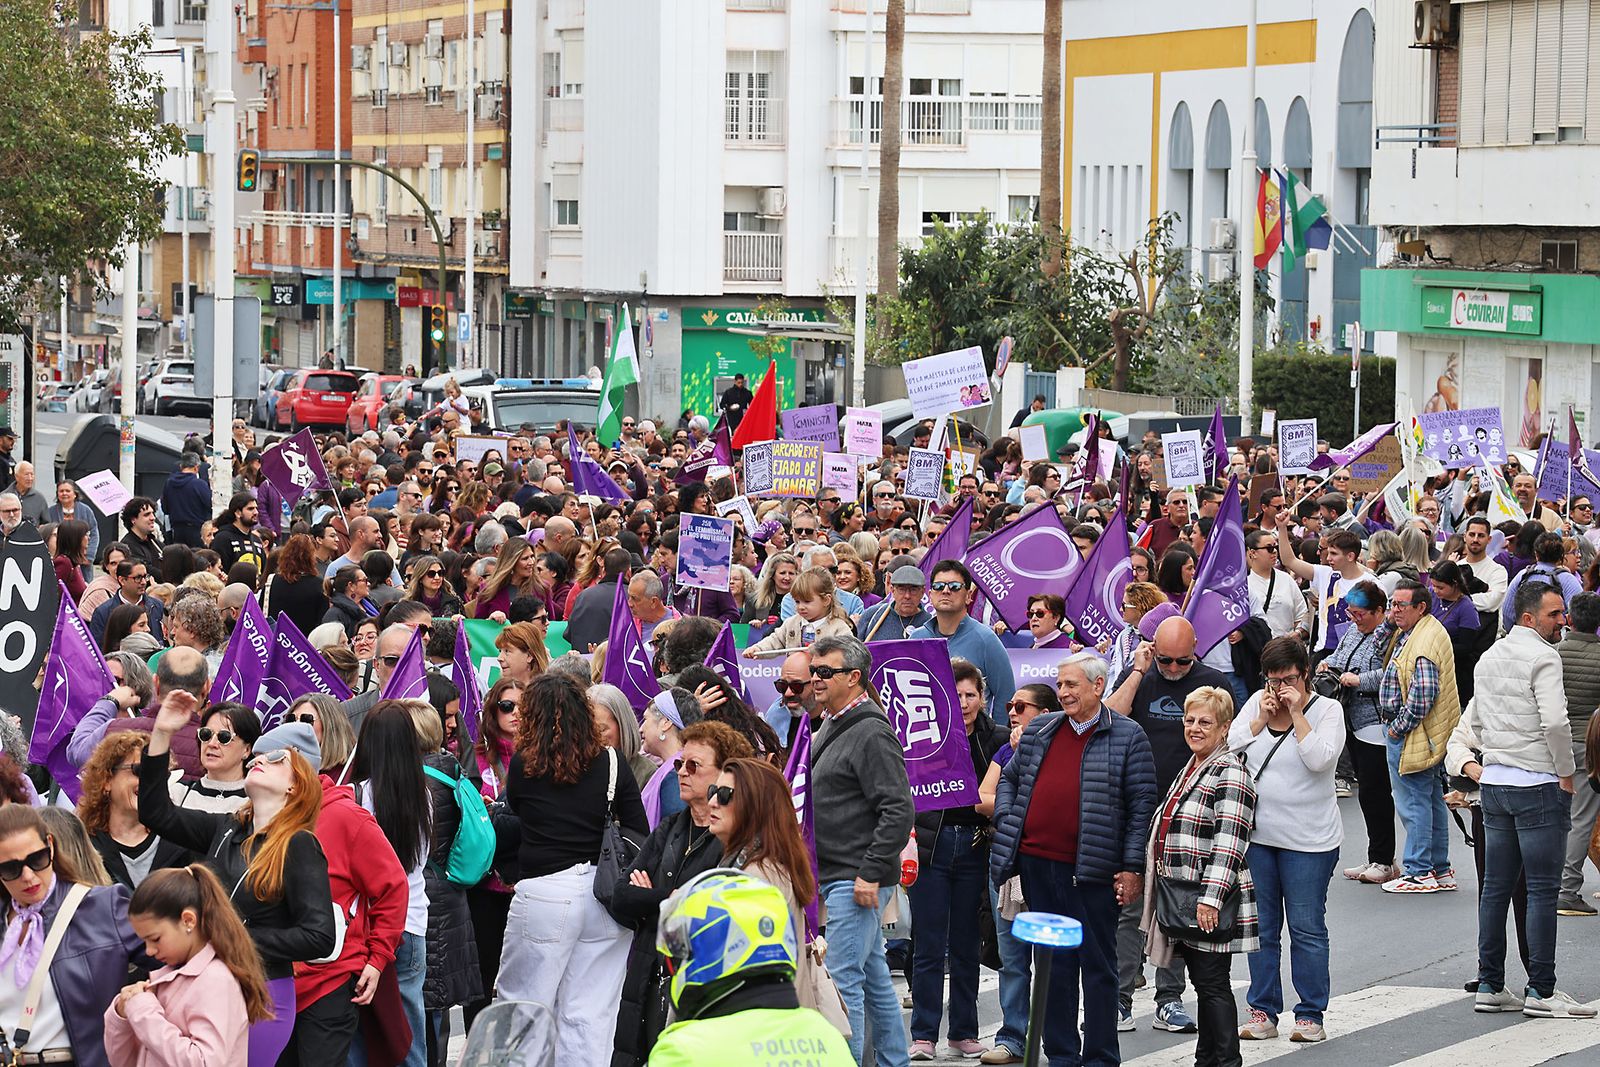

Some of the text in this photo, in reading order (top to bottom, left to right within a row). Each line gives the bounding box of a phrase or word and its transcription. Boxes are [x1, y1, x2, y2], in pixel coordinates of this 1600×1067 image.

[274, 294, 292, 304] 5€
[726, 312, 758, 324] CAJA
[1466, 303, 1505, 324] COVIRAN
[460, 317, 468, 336] P
[1288, 430, 1304, 440] 8M
[750, 451, 765, 463] 8M
[1174, 446, 1188, 456] 8M
[804, 460, 816, 476] DE
[916, 459, 932, 468] 8M
[695, 526, 724, 536] FEMINISMO
[970, 557, 1008, 600] PODEMOS
[984, 554, 1014, 589] EN HUELVA
[1086, 604, 1120, 638] EN HUE
[1020, 664, 1058, 678] Pode
[896, 670, 942, 744] UGT
[750, 1038, 828, 1057] POLICIA
